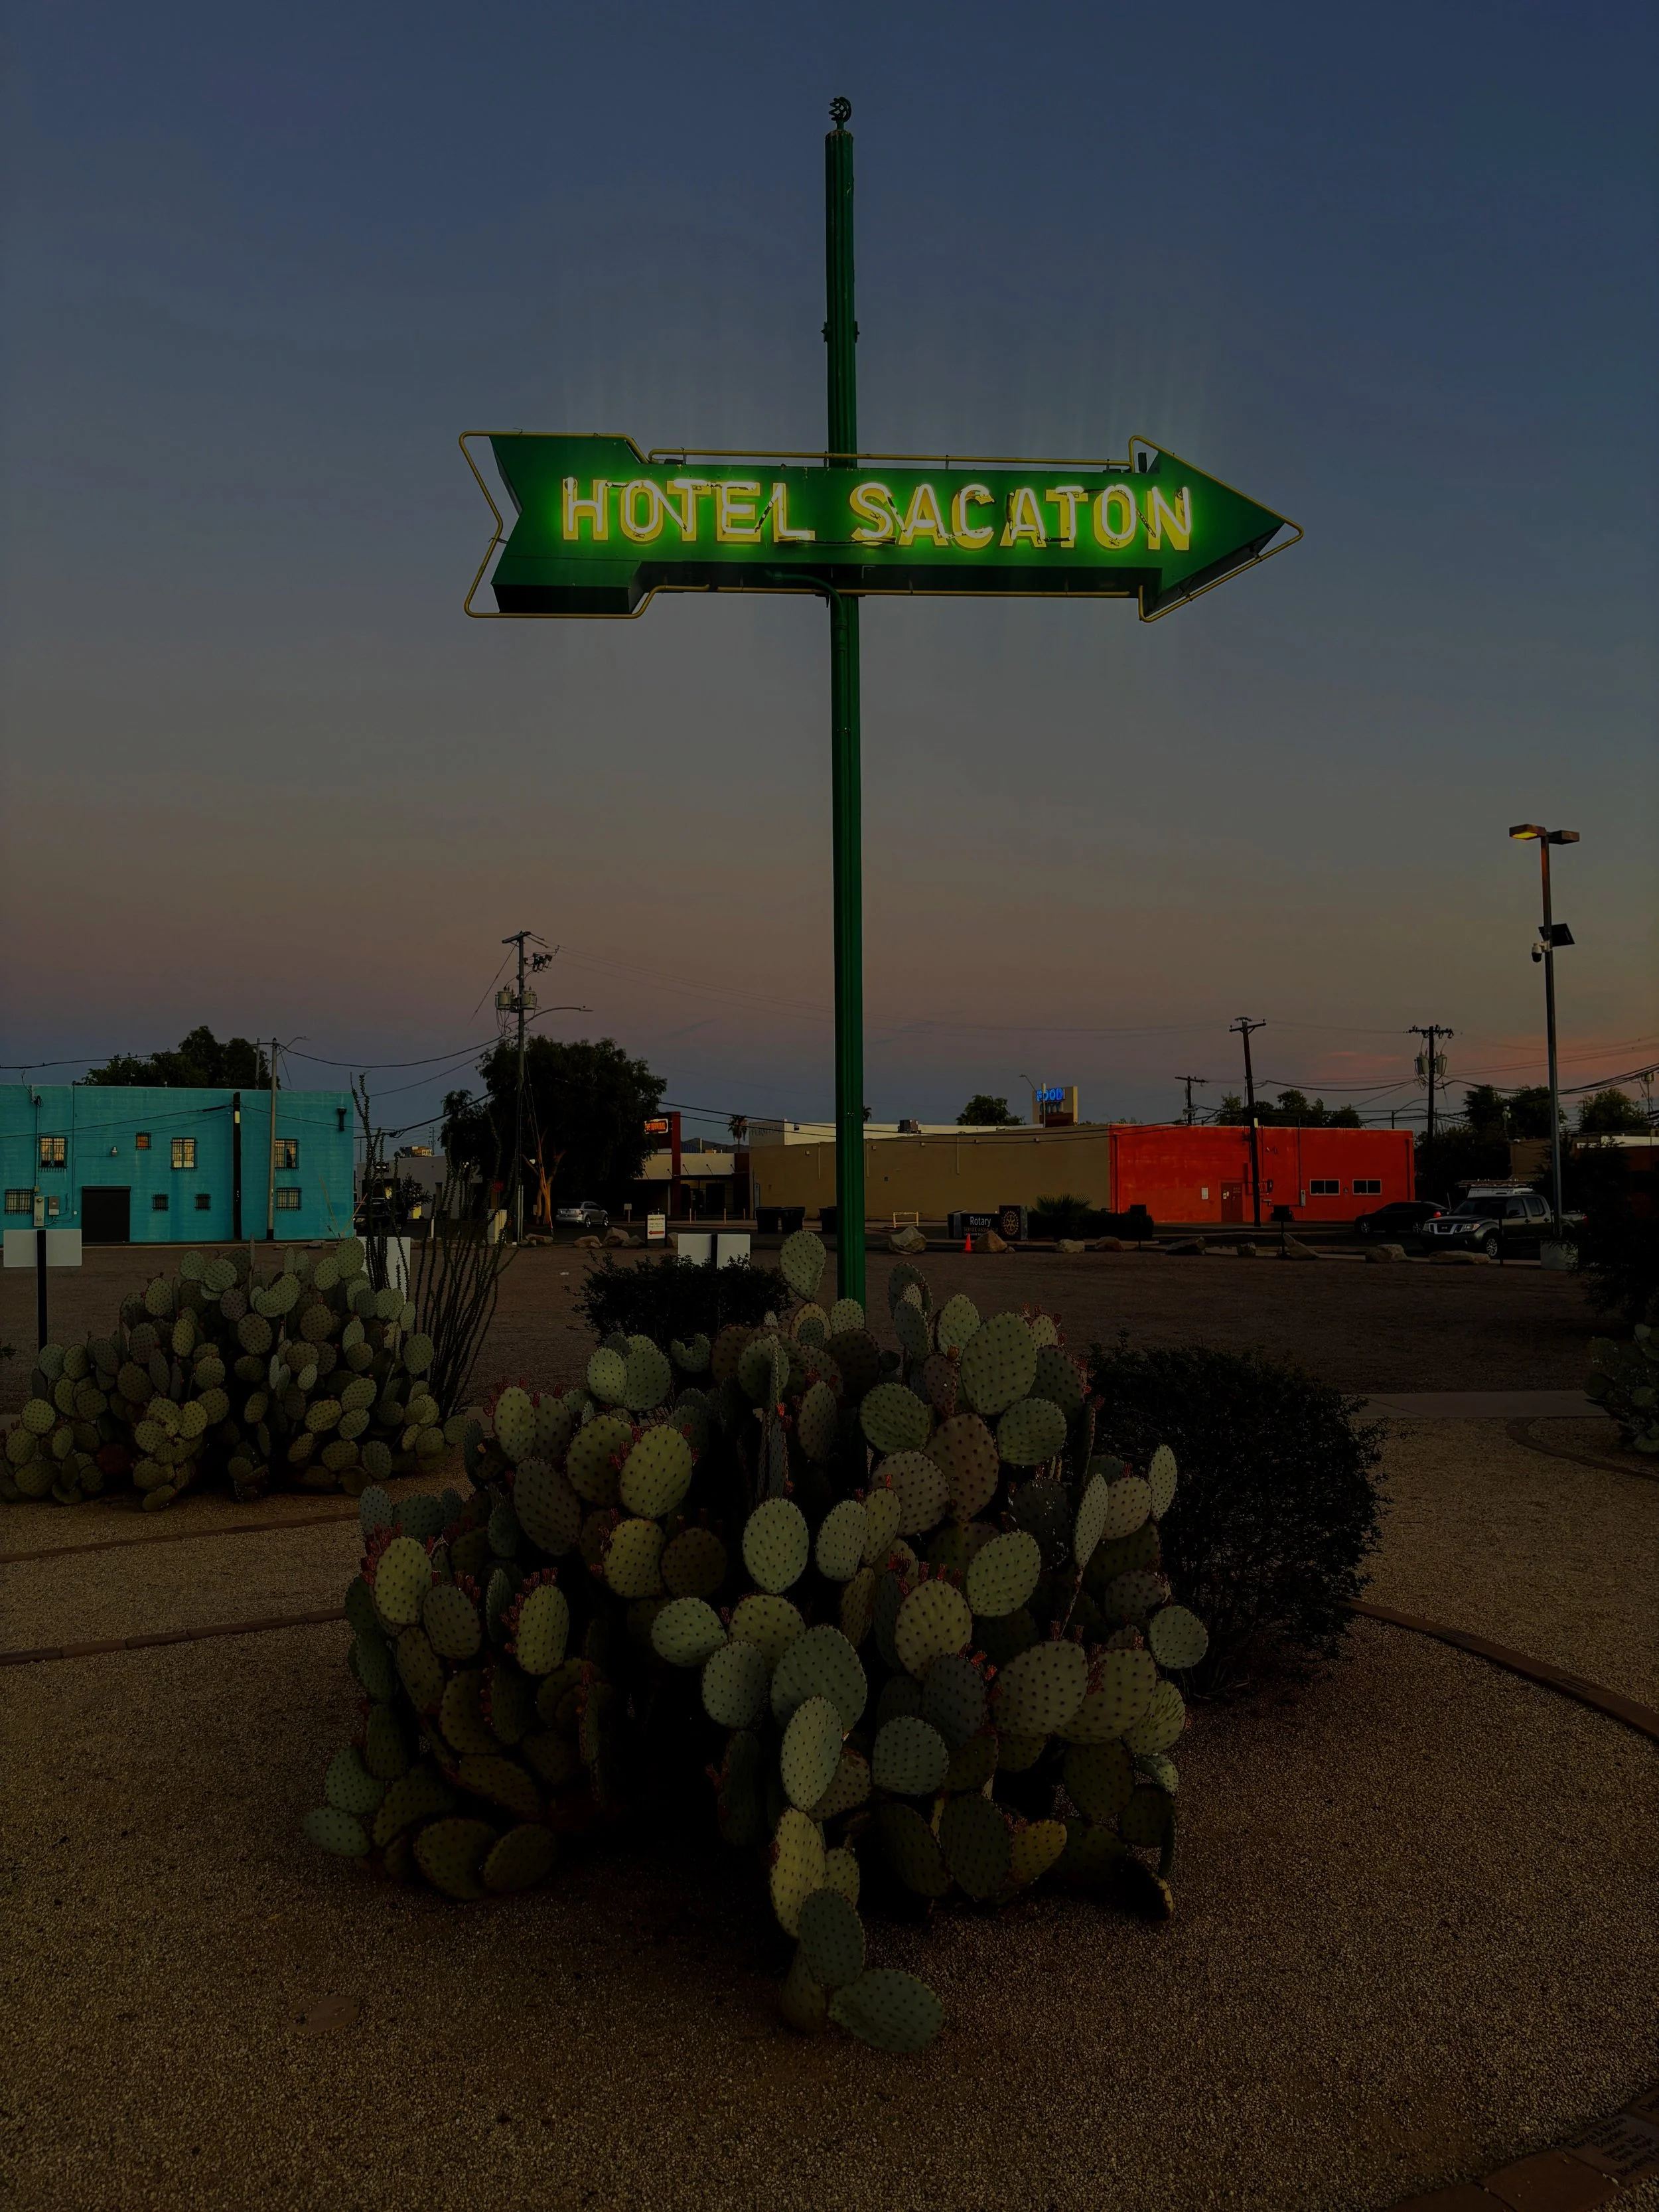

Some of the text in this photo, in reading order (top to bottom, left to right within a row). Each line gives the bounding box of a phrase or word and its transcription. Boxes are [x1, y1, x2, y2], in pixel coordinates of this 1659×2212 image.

[562, 477, 1192, 552] HOTEL SACATON
[1037, 1088, 1064, 1102] FOOD
[970, 1216, 991, 1228] Rotary
